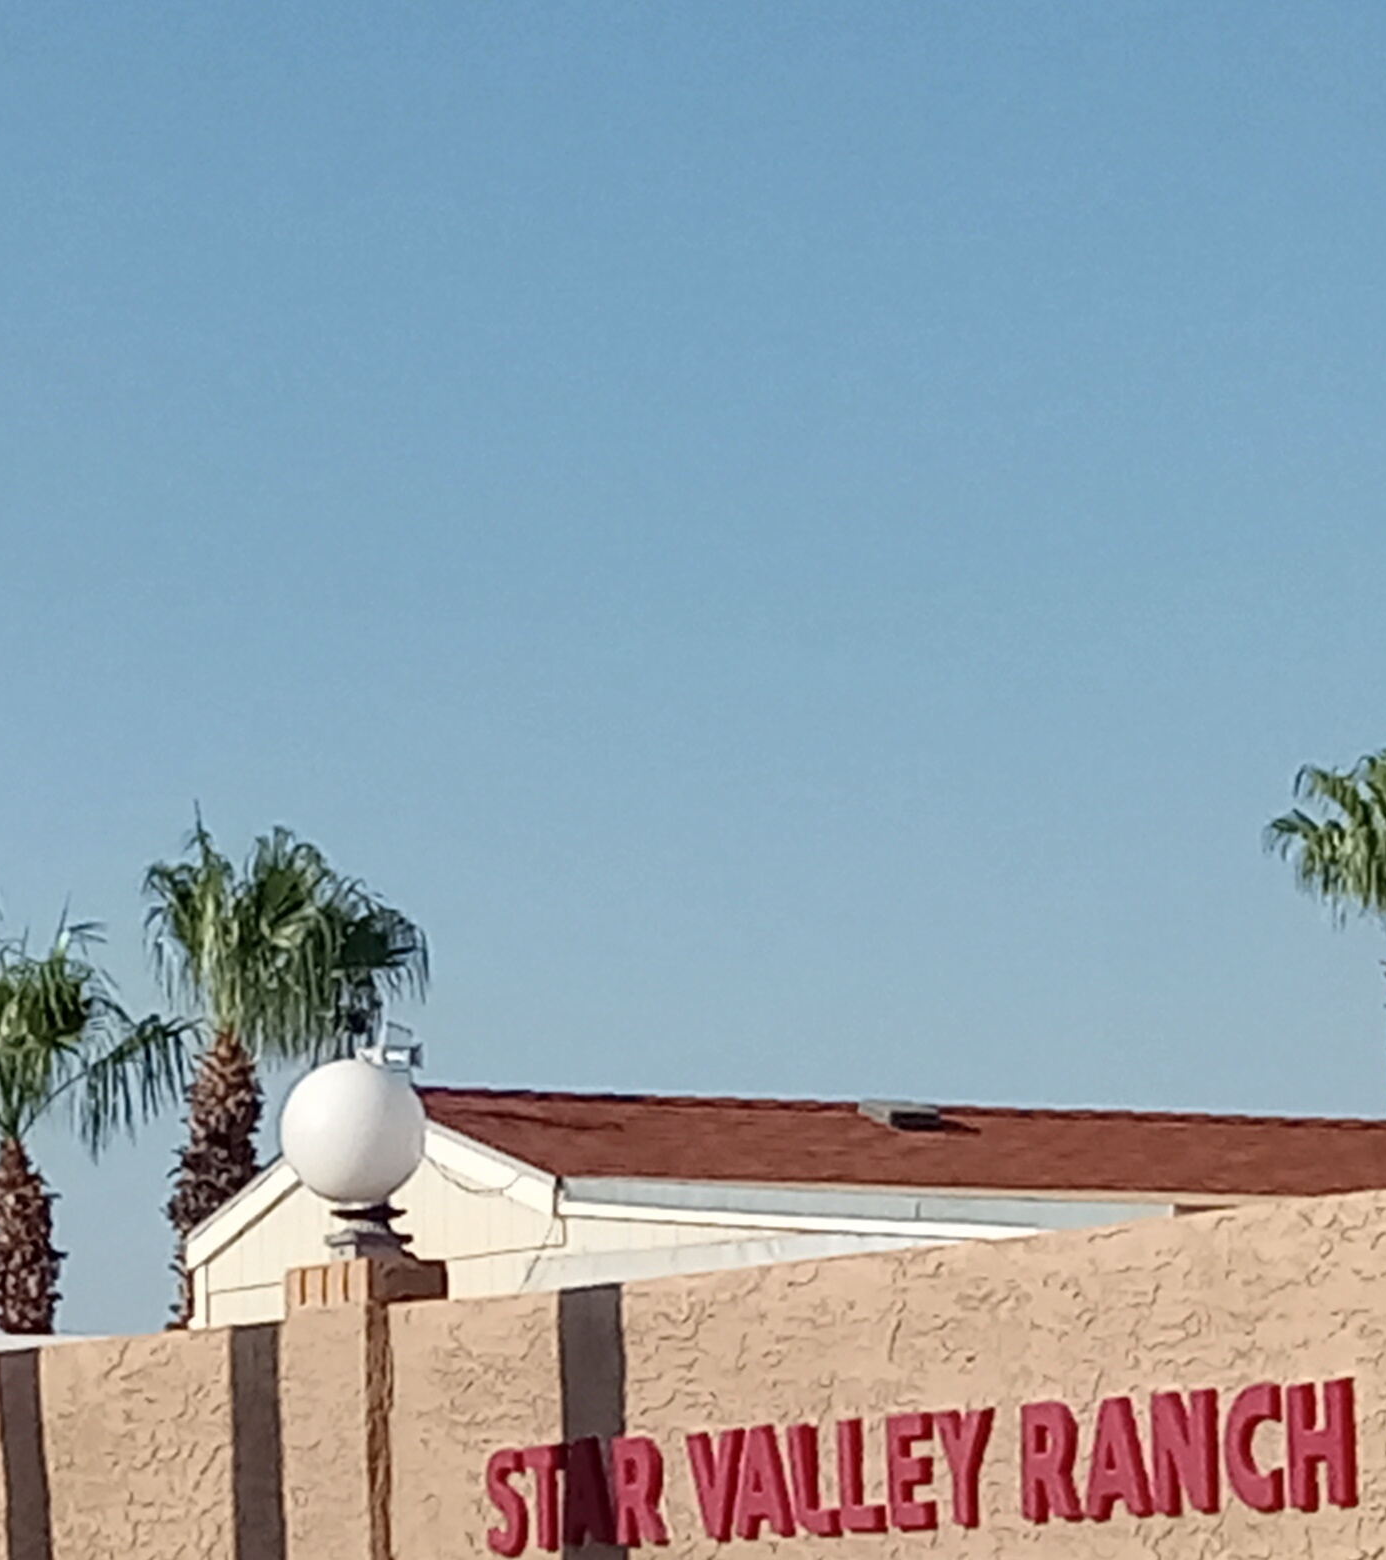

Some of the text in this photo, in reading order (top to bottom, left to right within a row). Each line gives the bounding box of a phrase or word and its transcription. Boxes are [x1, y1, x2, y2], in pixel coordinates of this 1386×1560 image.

[487, 1377, 1359, 1558] STAR VALLEY RANCH
